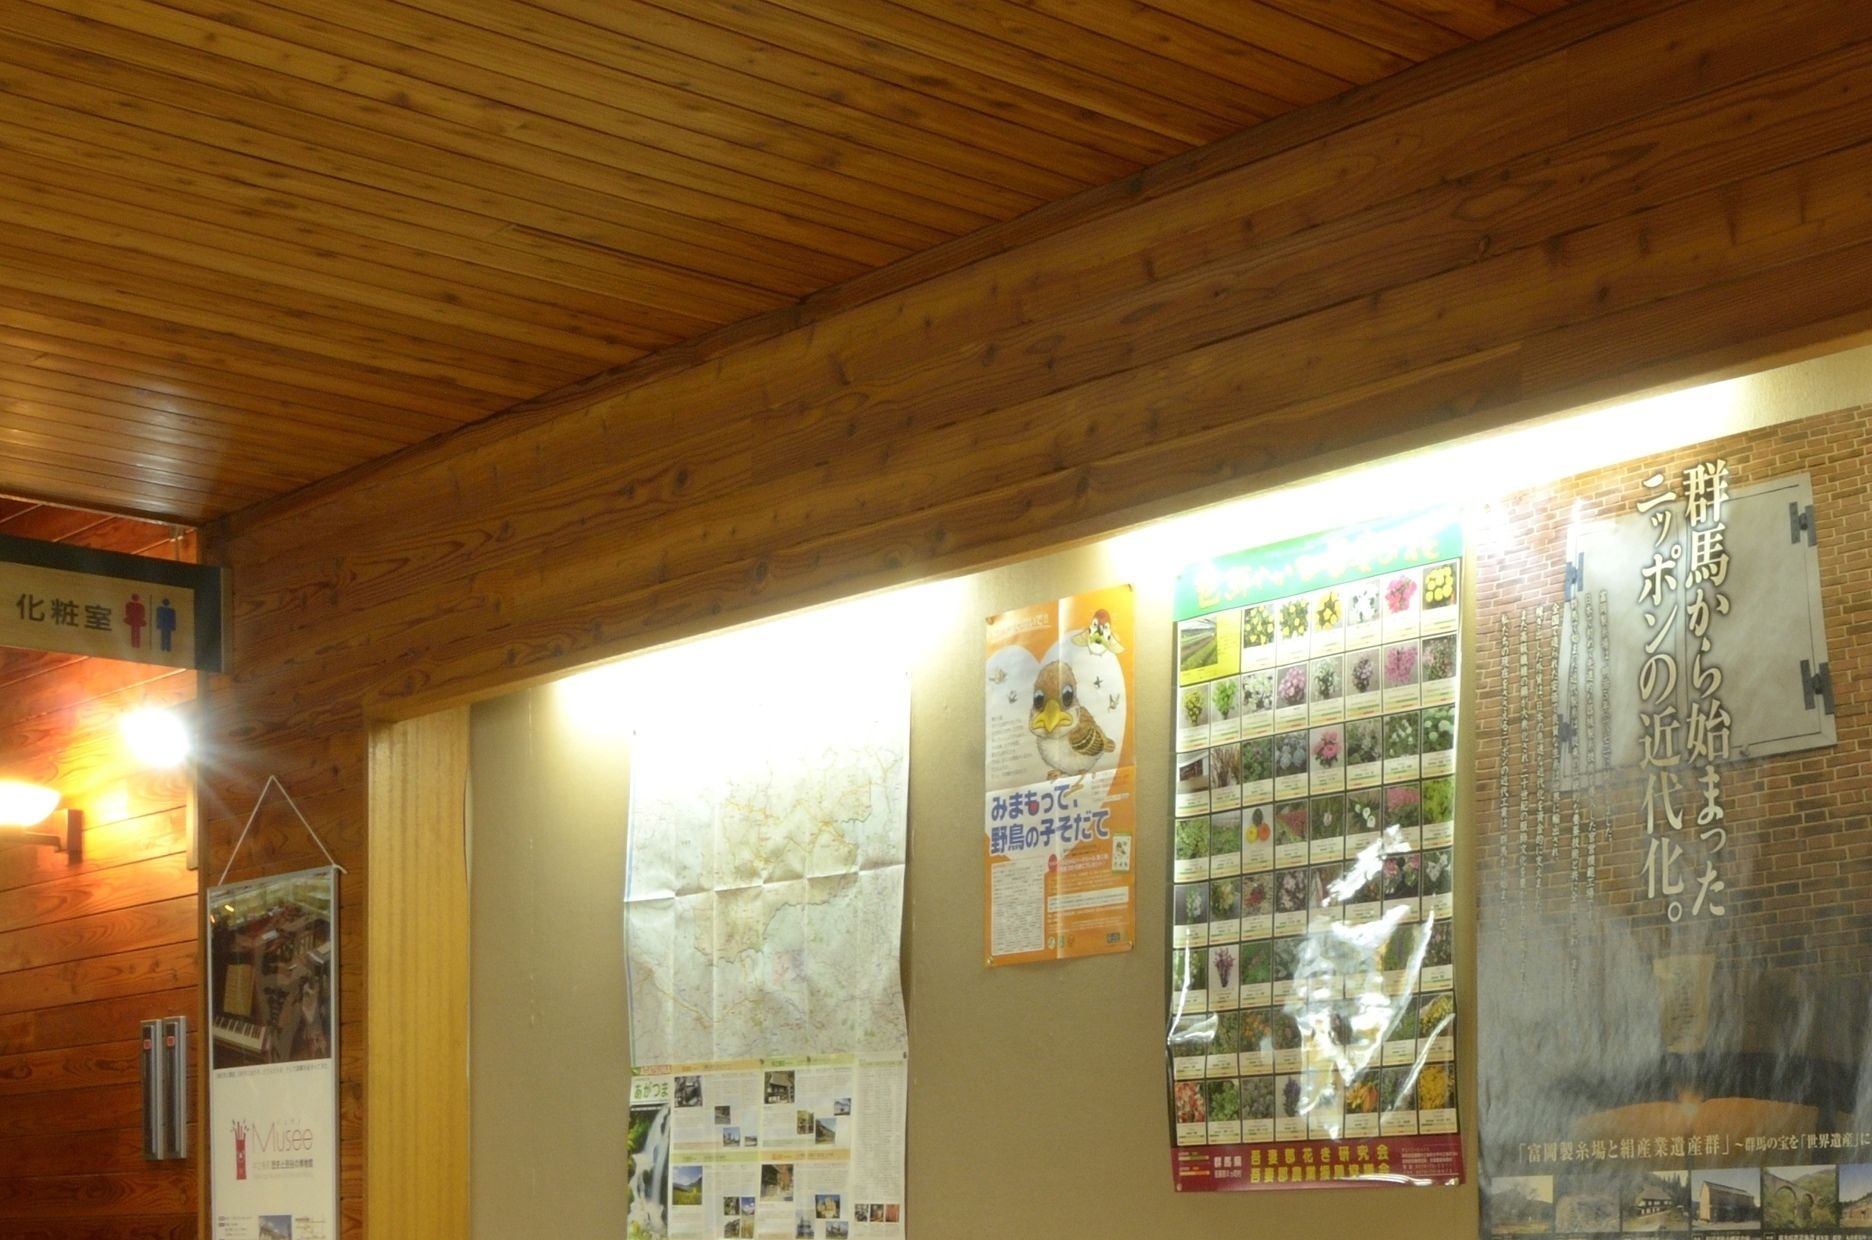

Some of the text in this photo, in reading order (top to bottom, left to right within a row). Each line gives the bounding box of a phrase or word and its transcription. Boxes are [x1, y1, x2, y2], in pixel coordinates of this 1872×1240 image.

[16, 594, 112, 632] 化粧室
[1636, 473, 1685, 923] ニッポンの近代化。
[1684, 459, 1731, 917] 群馬から始まった
[991, 784, 1078, 821] みまもって、
[991, 810, 1110, 854] 野鳥の子そだて
